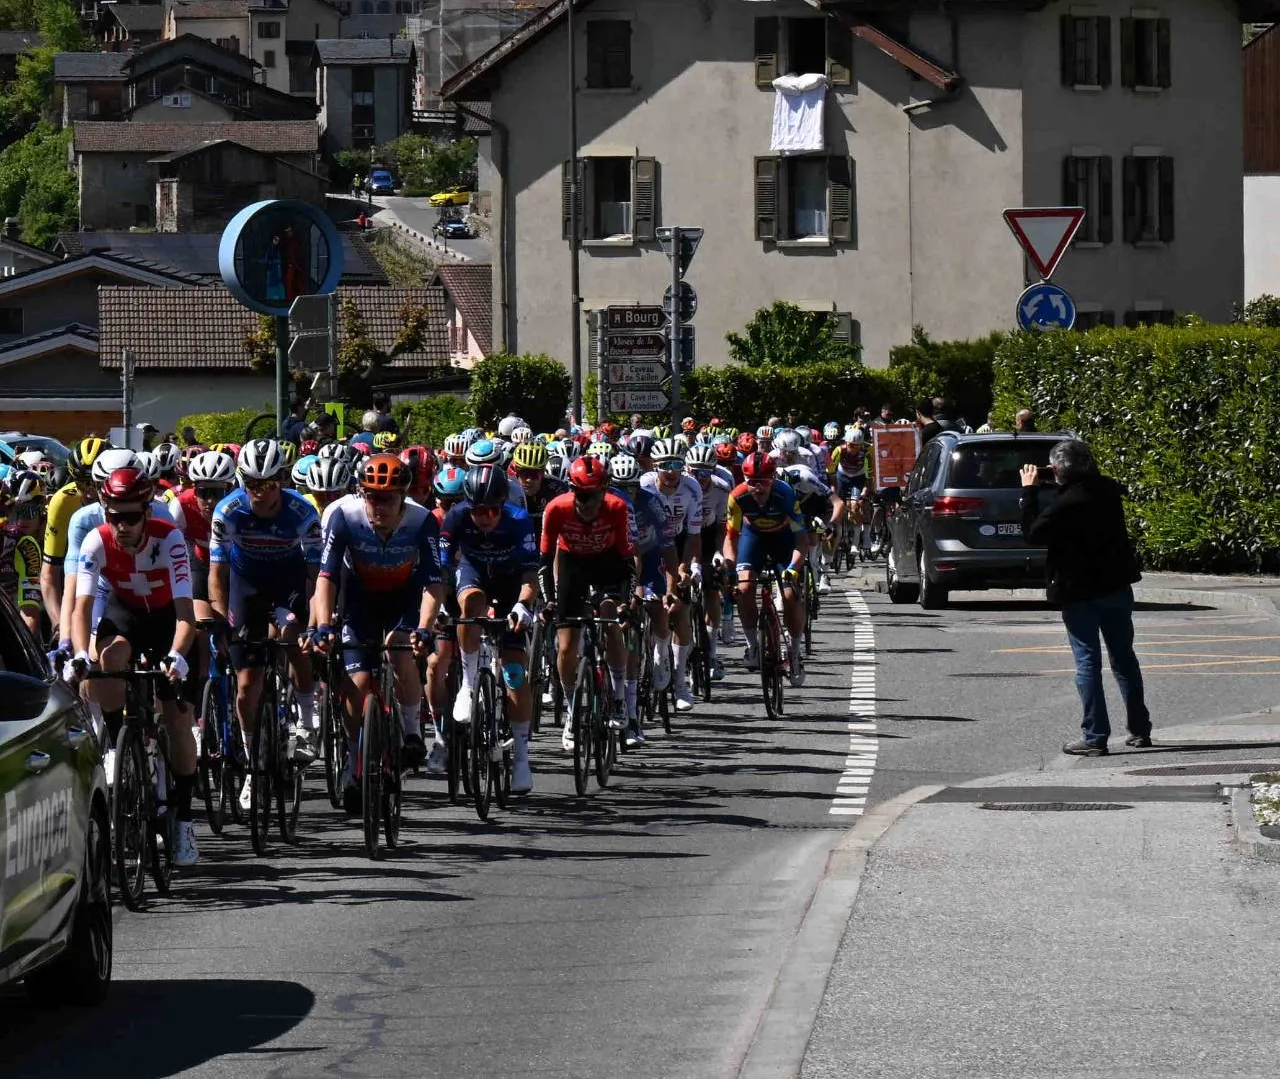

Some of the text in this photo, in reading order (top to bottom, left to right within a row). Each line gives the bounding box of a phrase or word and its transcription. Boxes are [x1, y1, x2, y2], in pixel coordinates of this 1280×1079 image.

[625, 310, 659, 326] Bourg
[629, 365, 655, 373] Caveau
[630, 393, 646, 401] Cave
[5, 787, 73, 878] Europcar
